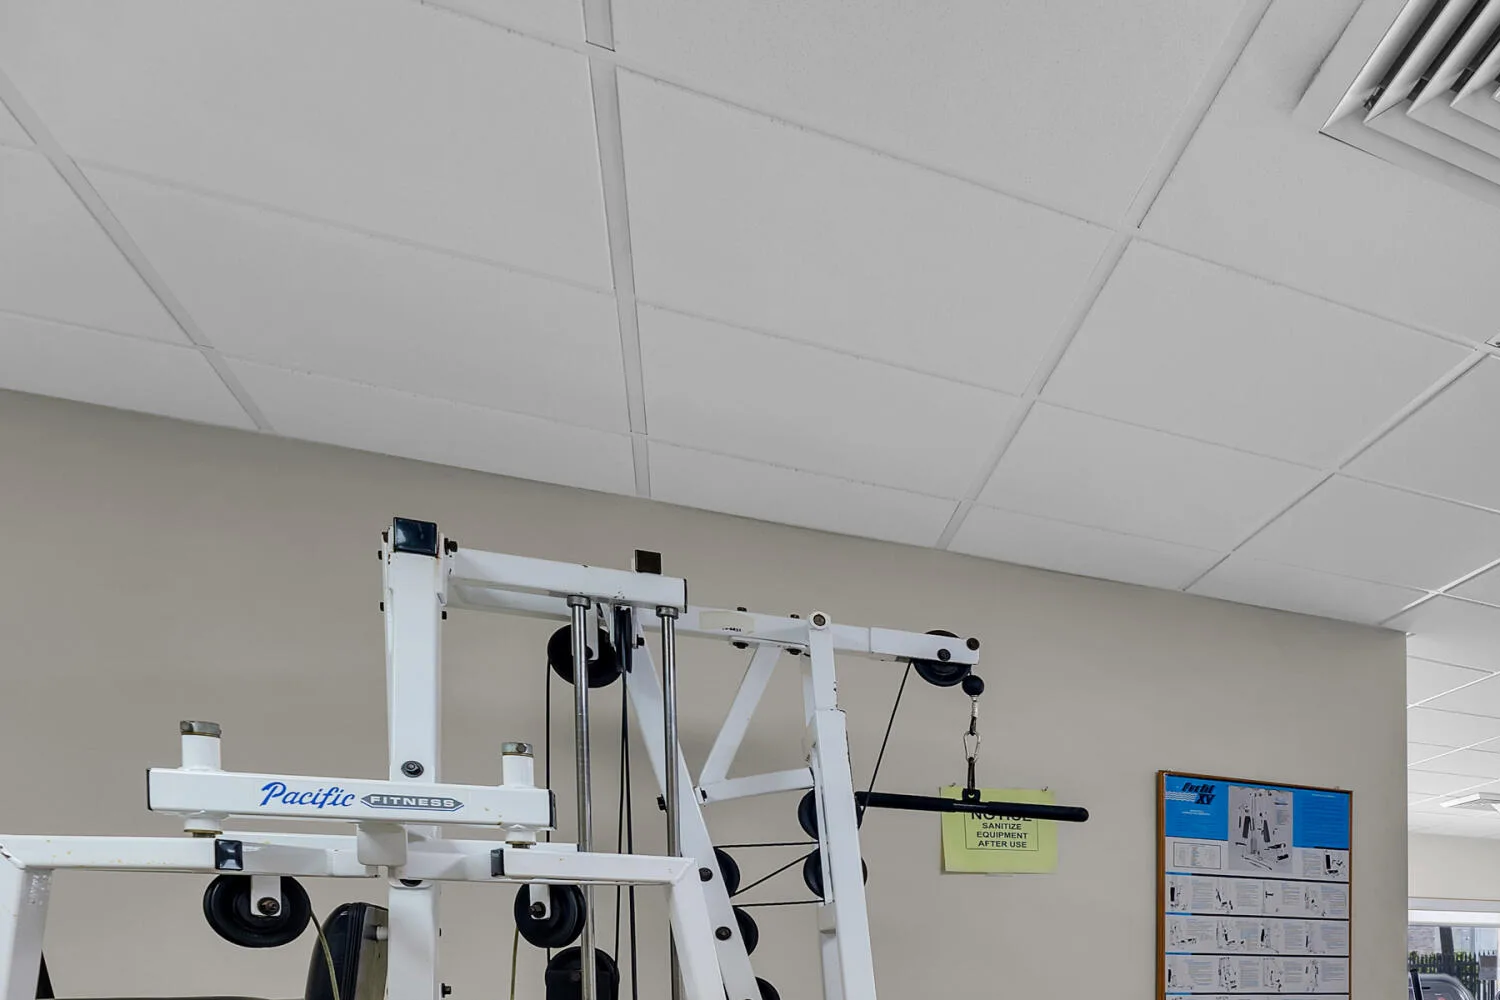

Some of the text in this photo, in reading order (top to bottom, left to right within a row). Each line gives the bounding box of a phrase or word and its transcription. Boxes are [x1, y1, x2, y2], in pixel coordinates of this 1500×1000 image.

[260, 781, 455, 809] Pacific FITNESS
[982, 822, 1022, 830] SANITIZE
[976, 831, 1027, 839] EQUIPMENT
